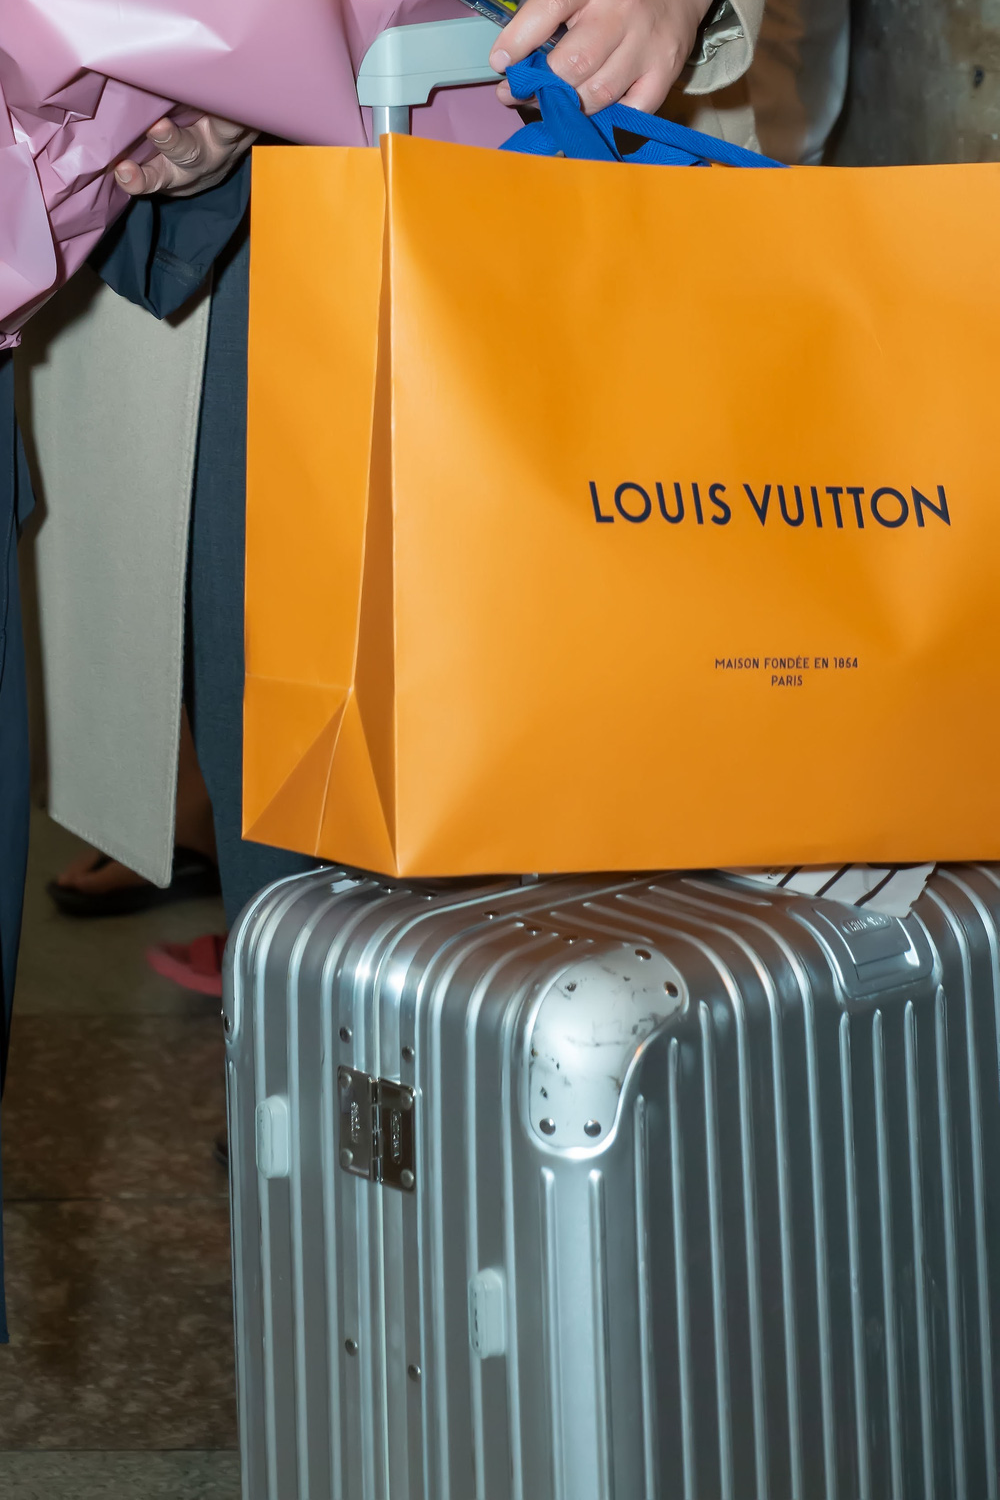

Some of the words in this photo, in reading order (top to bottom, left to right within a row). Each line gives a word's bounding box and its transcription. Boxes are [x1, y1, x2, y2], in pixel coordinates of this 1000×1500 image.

[588, 481, 732, 526] LOUIS
[742, 483, 951, 529] VUITTON
[714, 657, 760, 669] MAISON
[764, 654, 810, 669] FONDÉE
[814, 657, 829, 669] EN
[771, 674, 803, 687] PARIS
